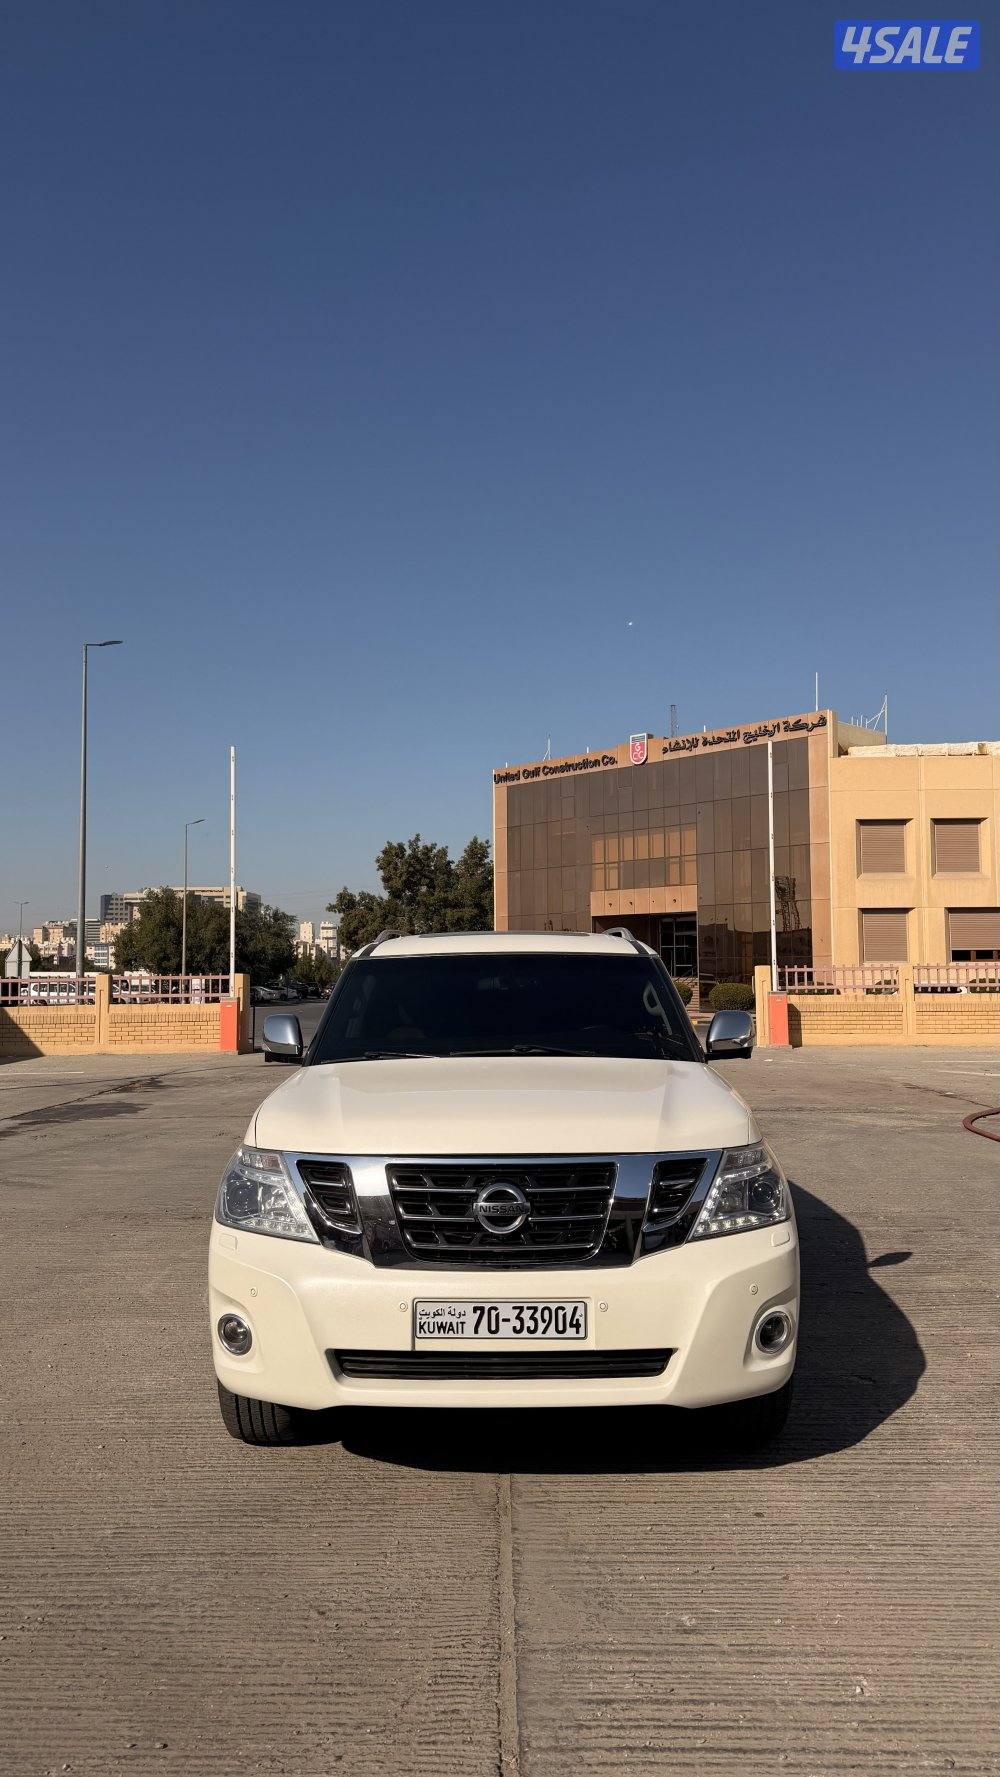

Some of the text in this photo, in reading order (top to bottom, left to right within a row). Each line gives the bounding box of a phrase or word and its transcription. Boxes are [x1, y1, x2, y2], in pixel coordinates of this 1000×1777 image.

[494, 754, 618, 784] United Gulf Construction Co.
[480, 1205, 526, 1213] NISSAN
[418, 1305, 467, 1320] دولة الكويت
[472, 1305, 582, 1335] 70-33904
[418, 1321, 466, 1335] KUWAIT
